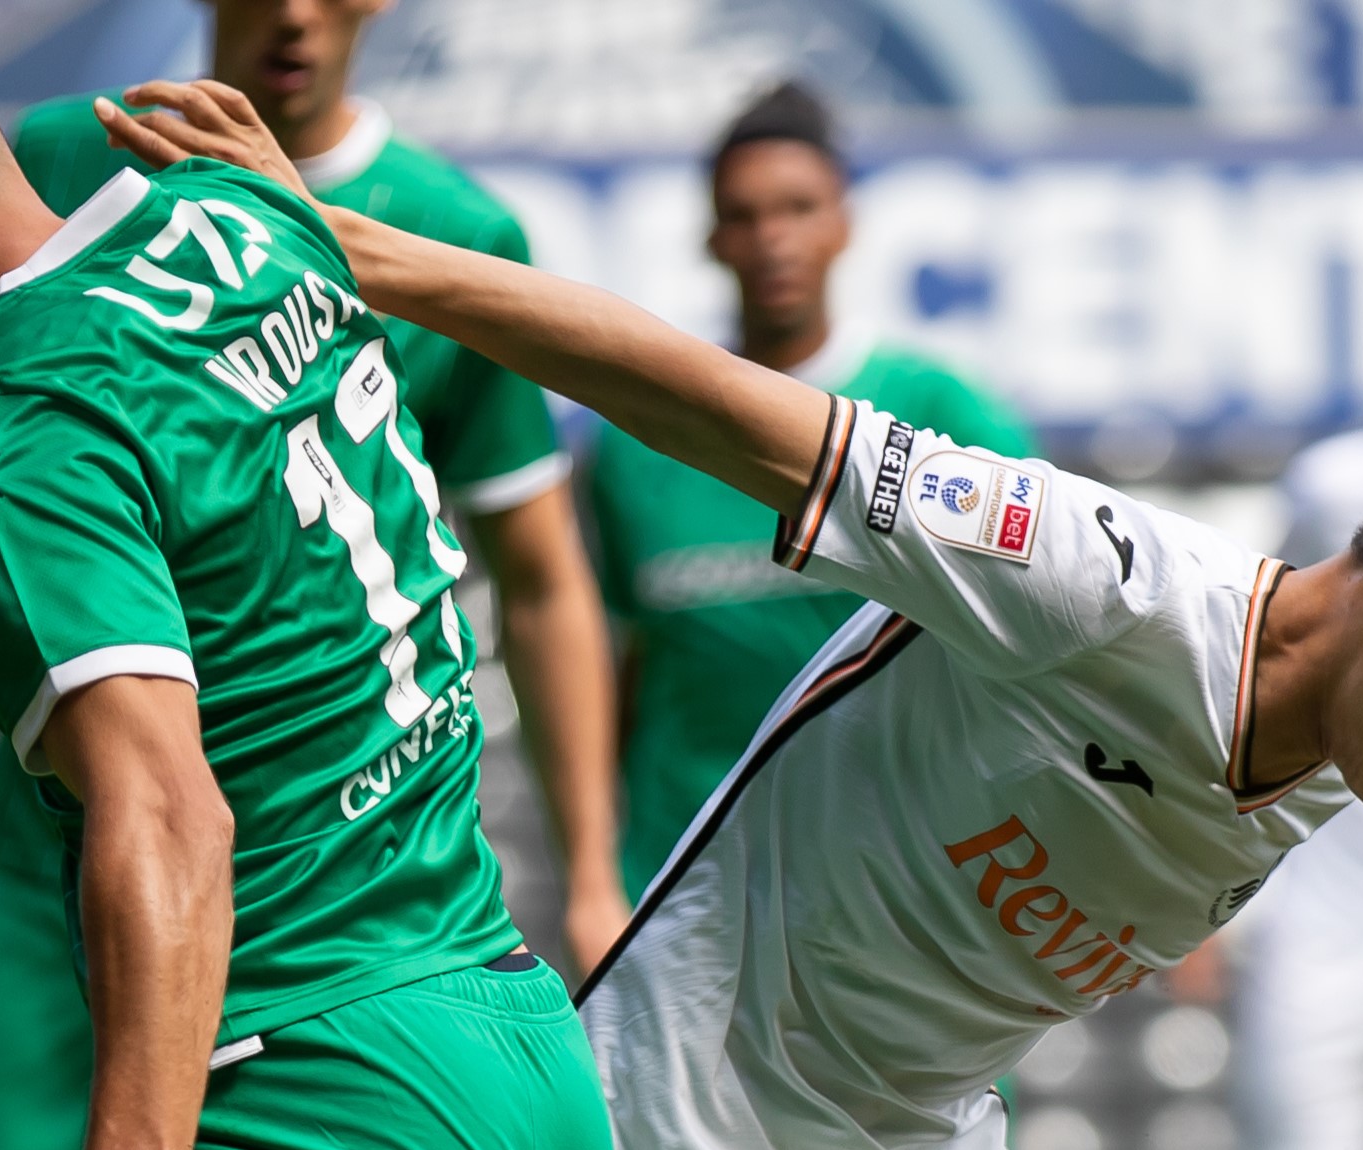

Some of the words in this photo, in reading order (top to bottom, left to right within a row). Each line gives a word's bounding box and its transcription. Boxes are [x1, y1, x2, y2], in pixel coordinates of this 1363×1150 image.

[919, 473, 939, 501] EFL
[1010, 474, 1034, 504] sky
[983, 468, 1006, 546] CHAMPIONSHIP
[1005, 509, 1029, 547] bet
